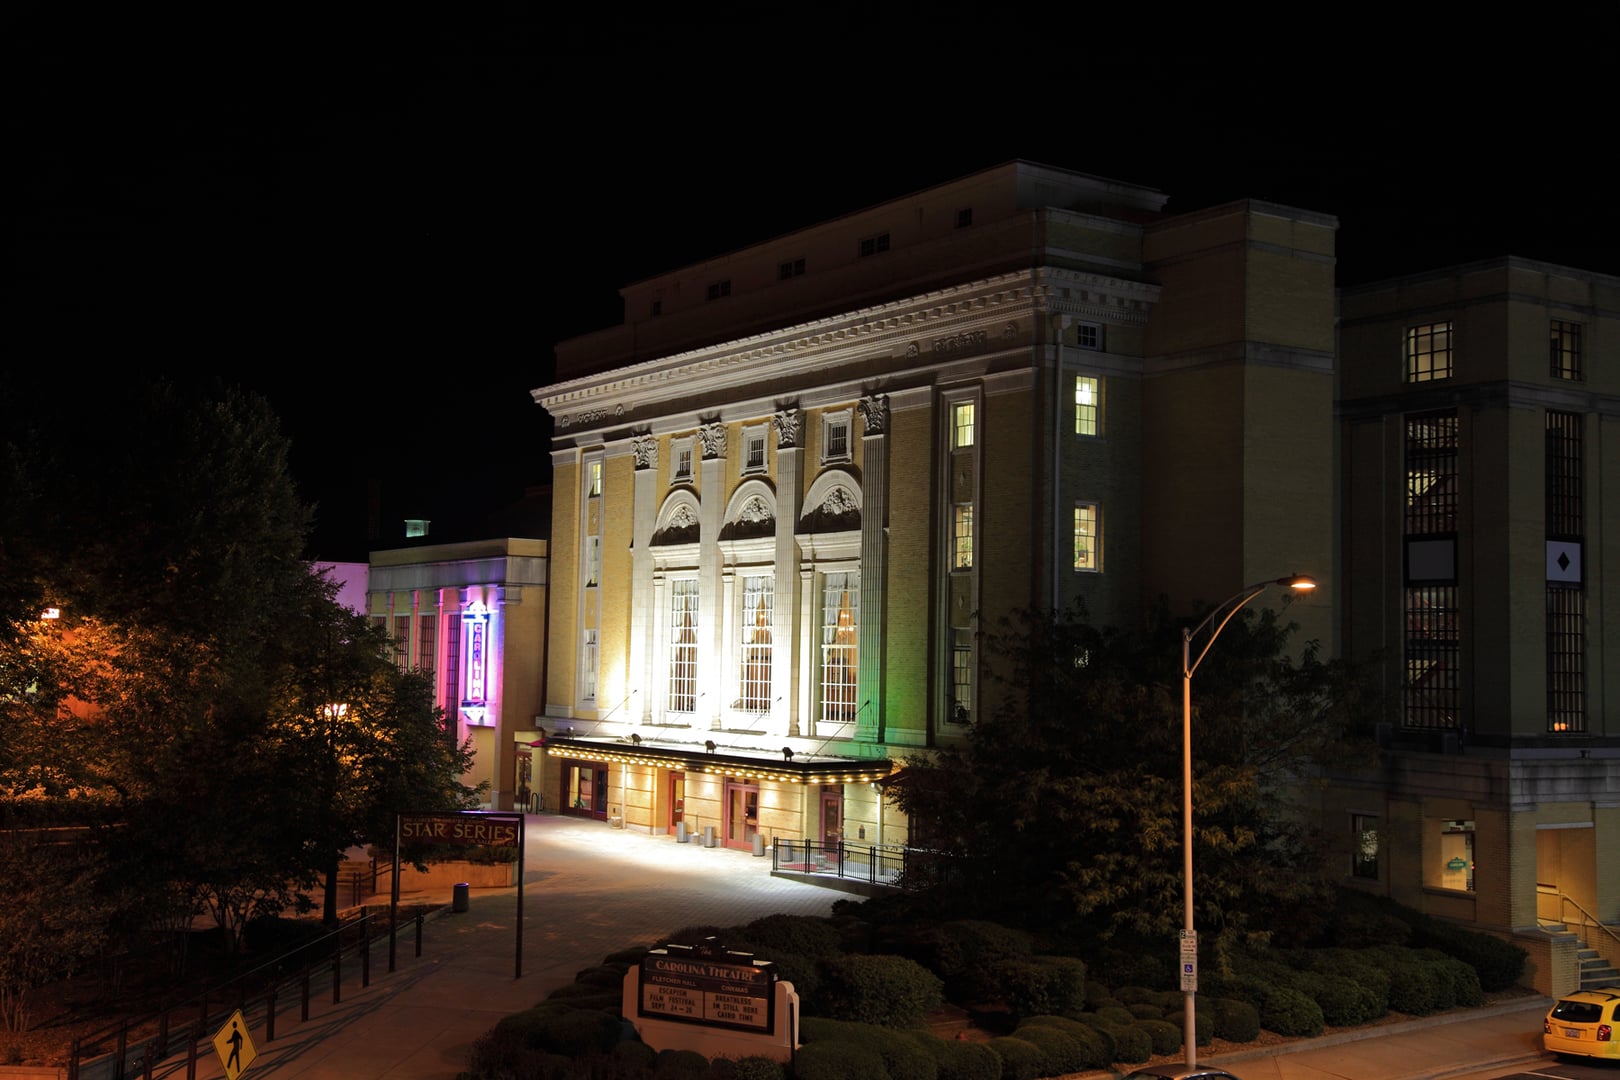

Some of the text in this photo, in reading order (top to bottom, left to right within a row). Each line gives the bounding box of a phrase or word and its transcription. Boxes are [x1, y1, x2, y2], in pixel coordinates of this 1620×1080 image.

[472, 624, 482, 698] CAROLINA
[403, 823, 515, 840] STAR SERIES
[656, 960, 755, 981] CAROLINA THEATRE
[652, 976, 696, 987] FLETCHER HALL
[721, 985, 748, 994] CINEMAS
[650, 994, 695, 1007] FILM FESTIVAL
[715, 995, 752, 1005] BREATHLESS
[651, 1002, 665, 1011] SEPT
[723, 1003, 739, 1013] STILL
[743, 1006, 758, 1015] HERE
[717, 1011, 753, 1022] CAIRO TIME
